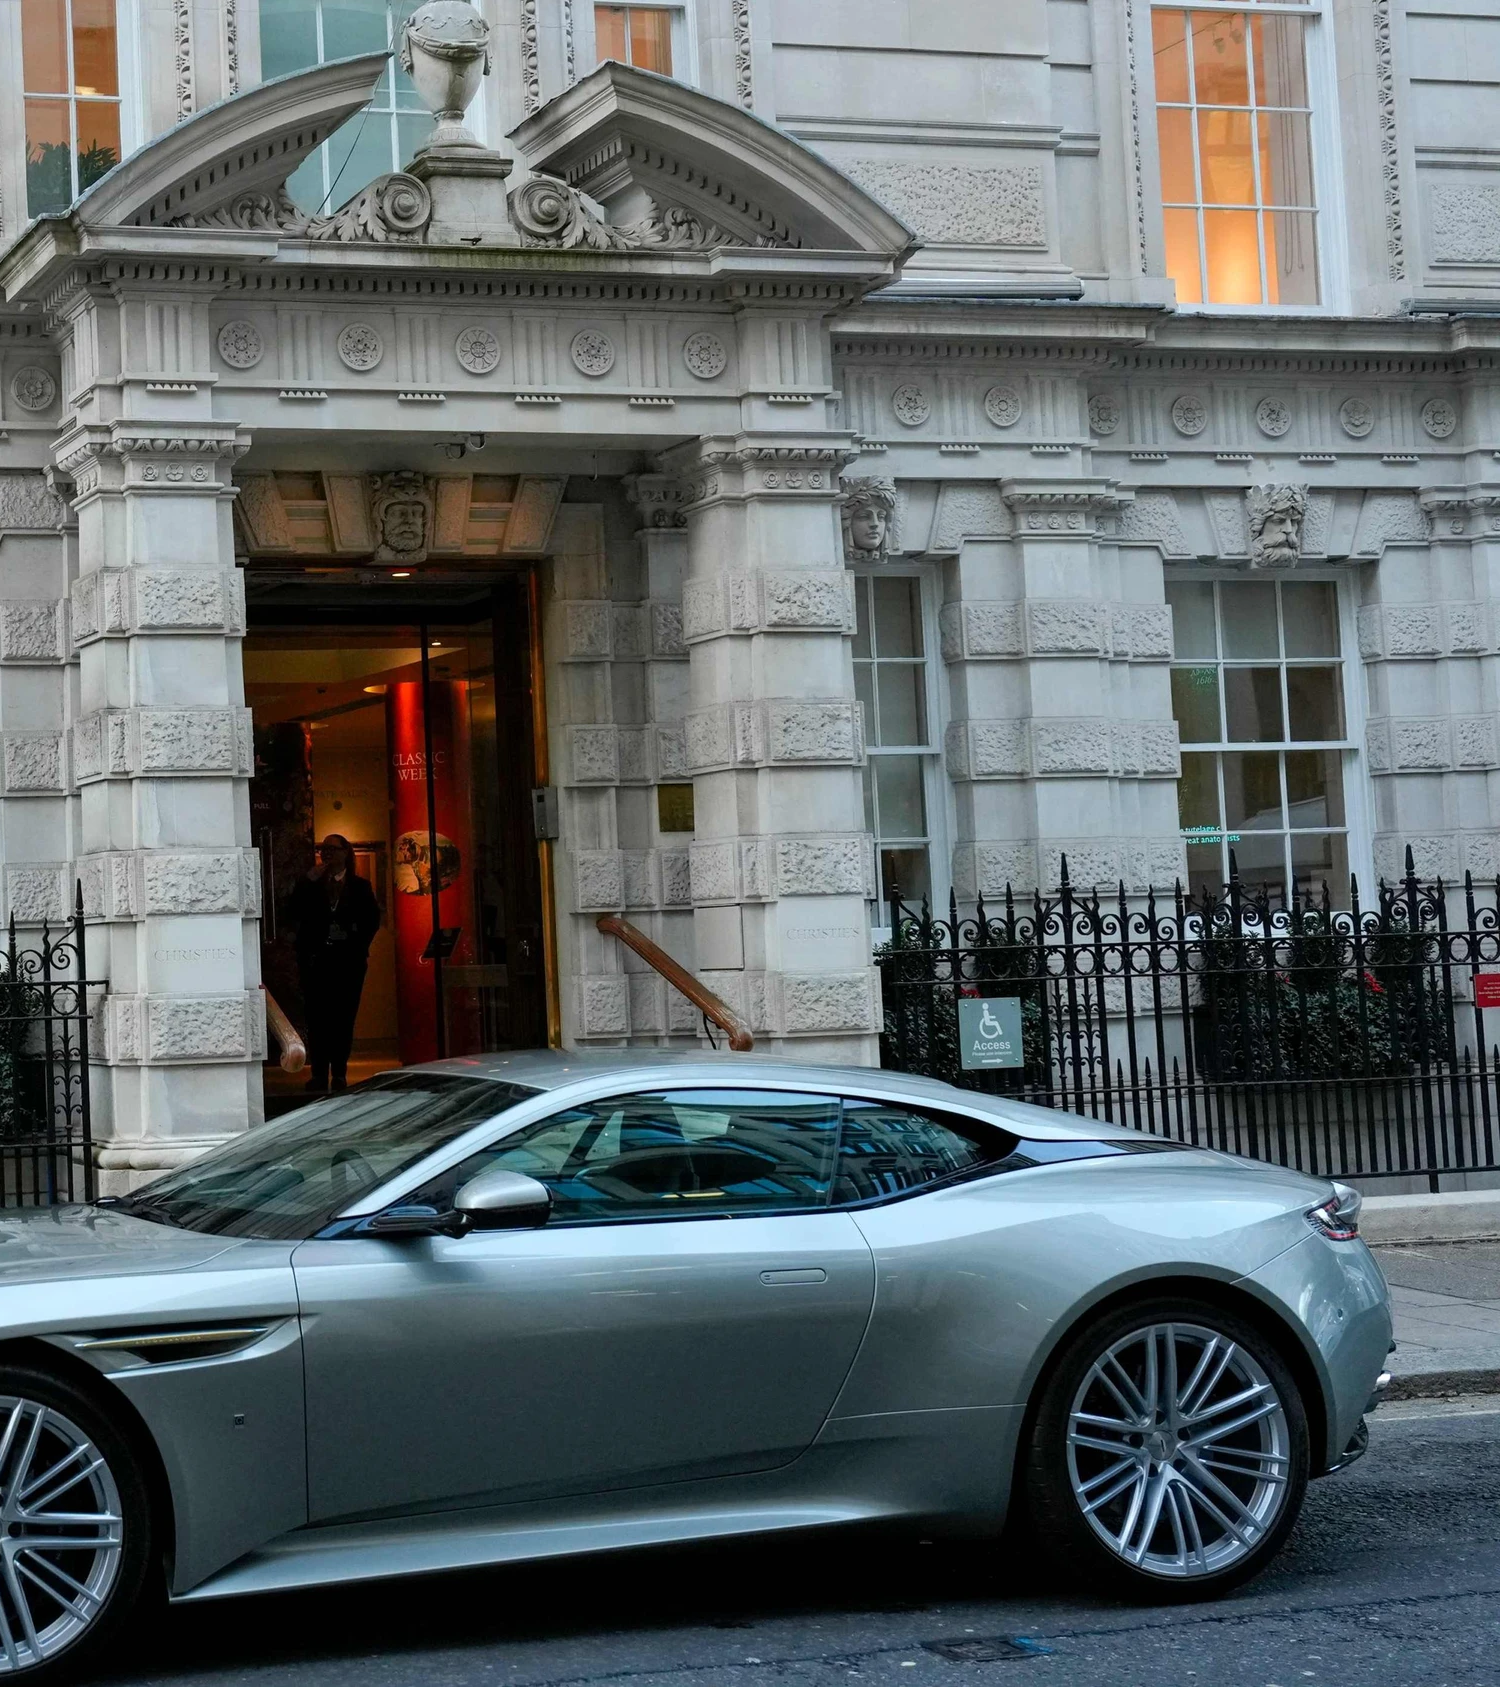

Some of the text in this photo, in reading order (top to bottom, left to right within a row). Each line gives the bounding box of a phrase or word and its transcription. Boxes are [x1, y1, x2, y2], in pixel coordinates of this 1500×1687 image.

[1201, 835, 1240, 843] anatoists
[786, 927, 860, 941] CHRISTIE'S
[154, 947, 238, 963] CHRISTIE'S
[973, 1040, 1011, 1051] Access
